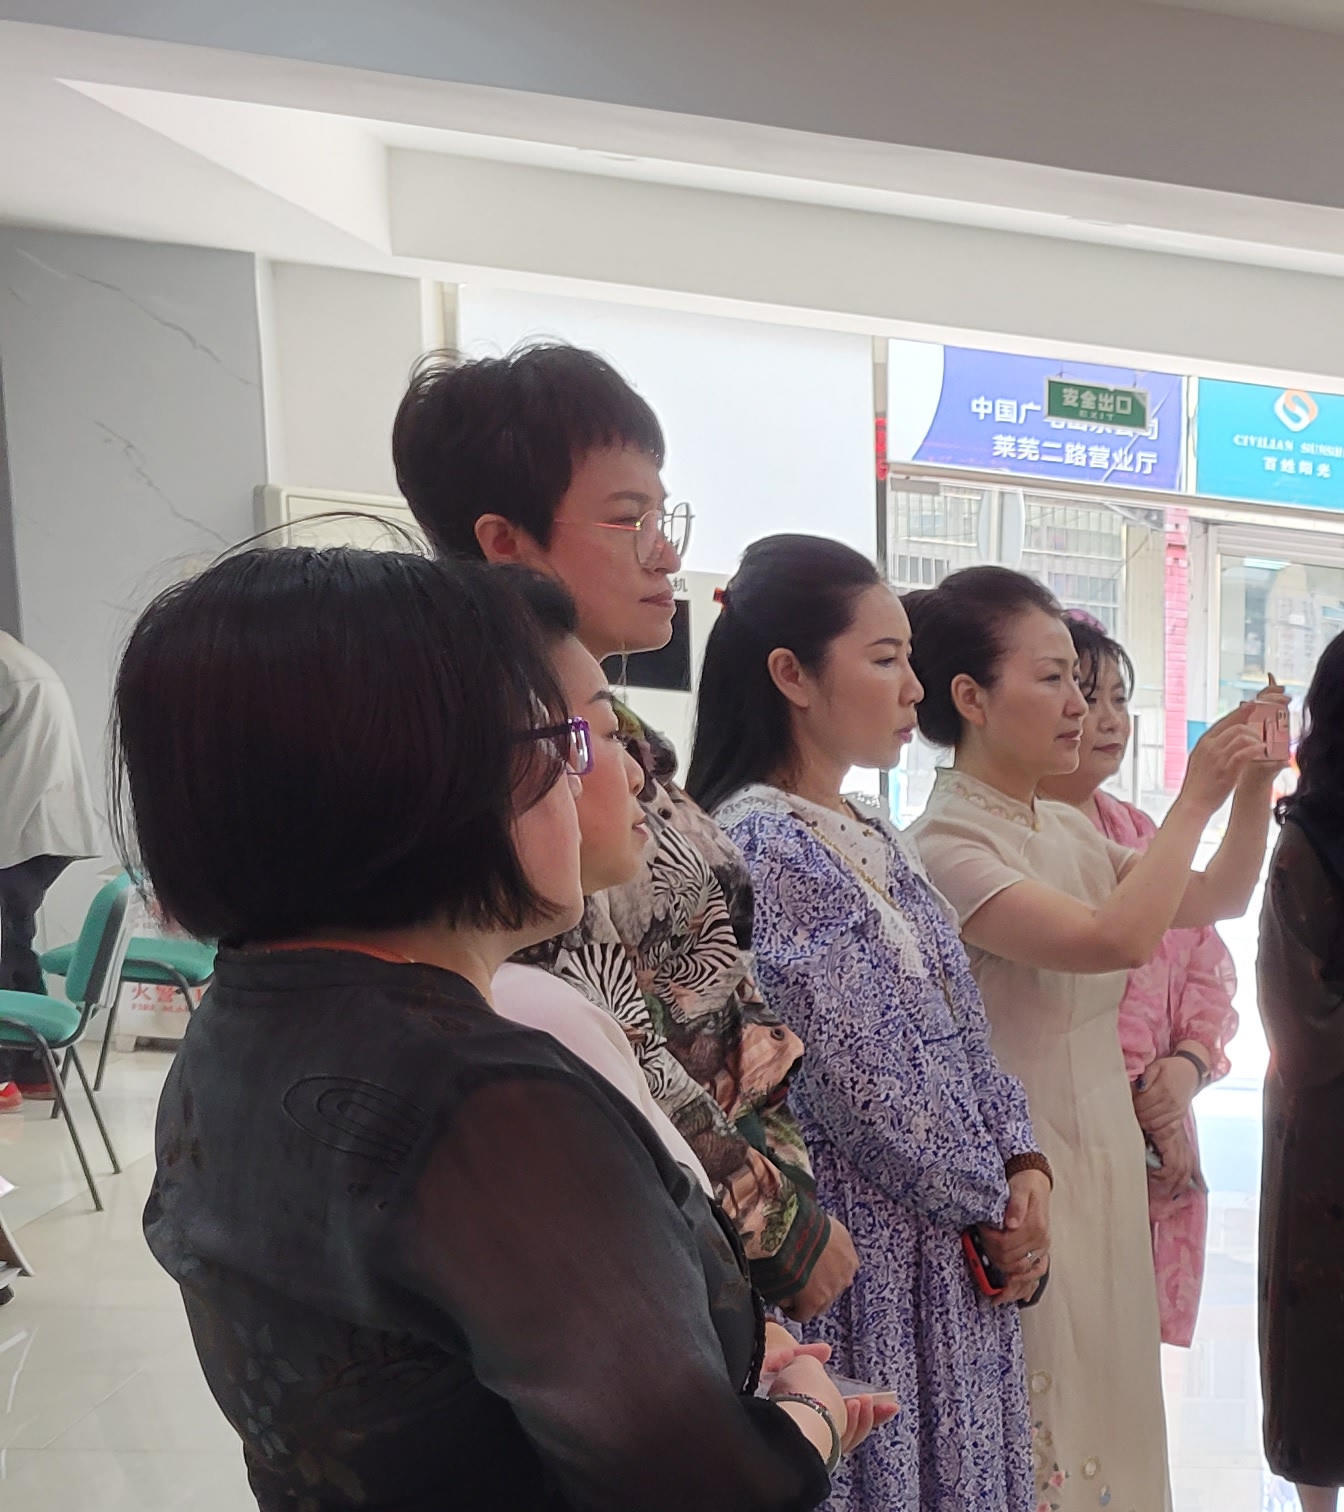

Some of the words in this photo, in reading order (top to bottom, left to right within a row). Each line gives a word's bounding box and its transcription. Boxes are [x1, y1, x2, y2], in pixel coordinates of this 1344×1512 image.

[1061, 388, 1132, 415] 安全出口
[992, 434, 1158, 475] 莱芜二路营业厅
[1233, 433, 1294, 452] CIVILIAN
[1263, 456, 1332, 479] 百姓阳光
